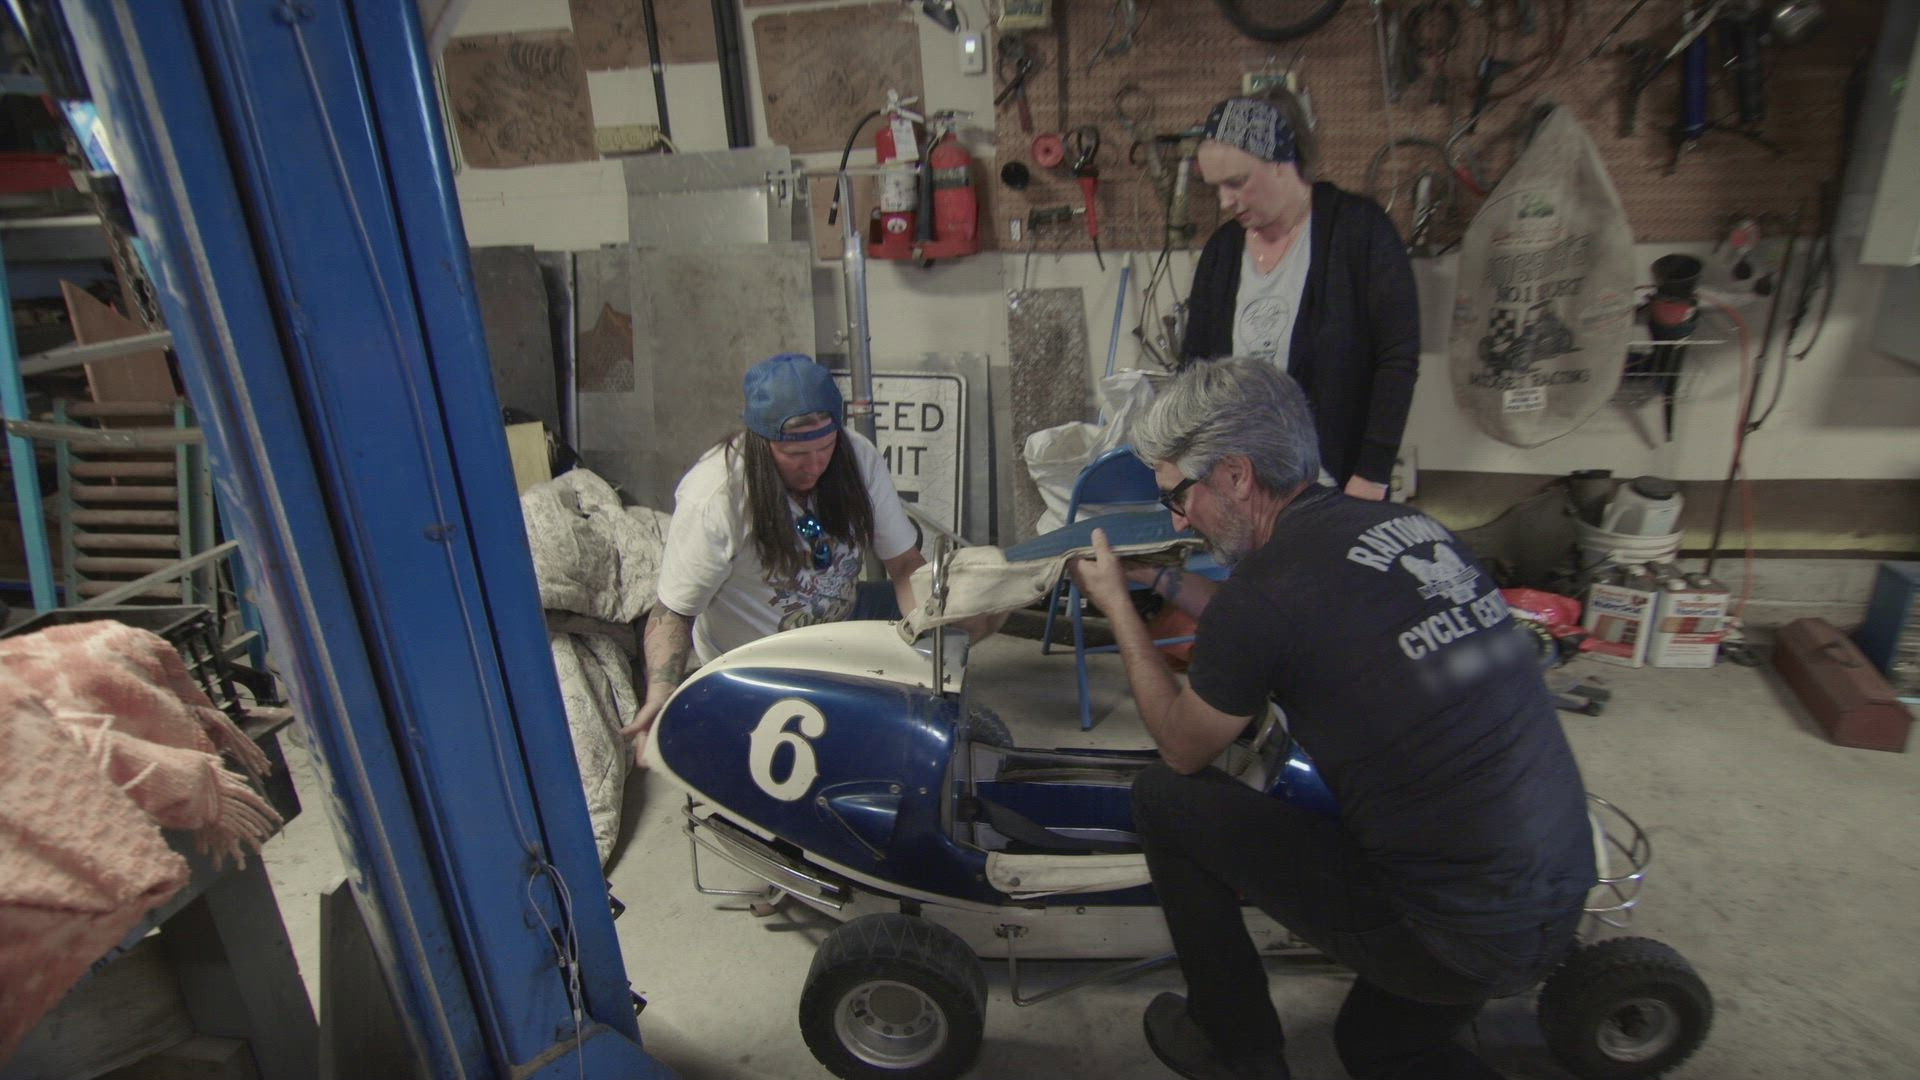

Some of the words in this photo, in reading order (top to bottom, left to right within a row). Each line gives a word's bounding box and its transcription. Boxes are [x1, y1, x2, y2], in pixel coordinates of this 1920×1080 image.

[843, 401, 944, 432] EED
[1398, 606, 1477, 660] CYCLE
[749, 697, 827, 801] 6
